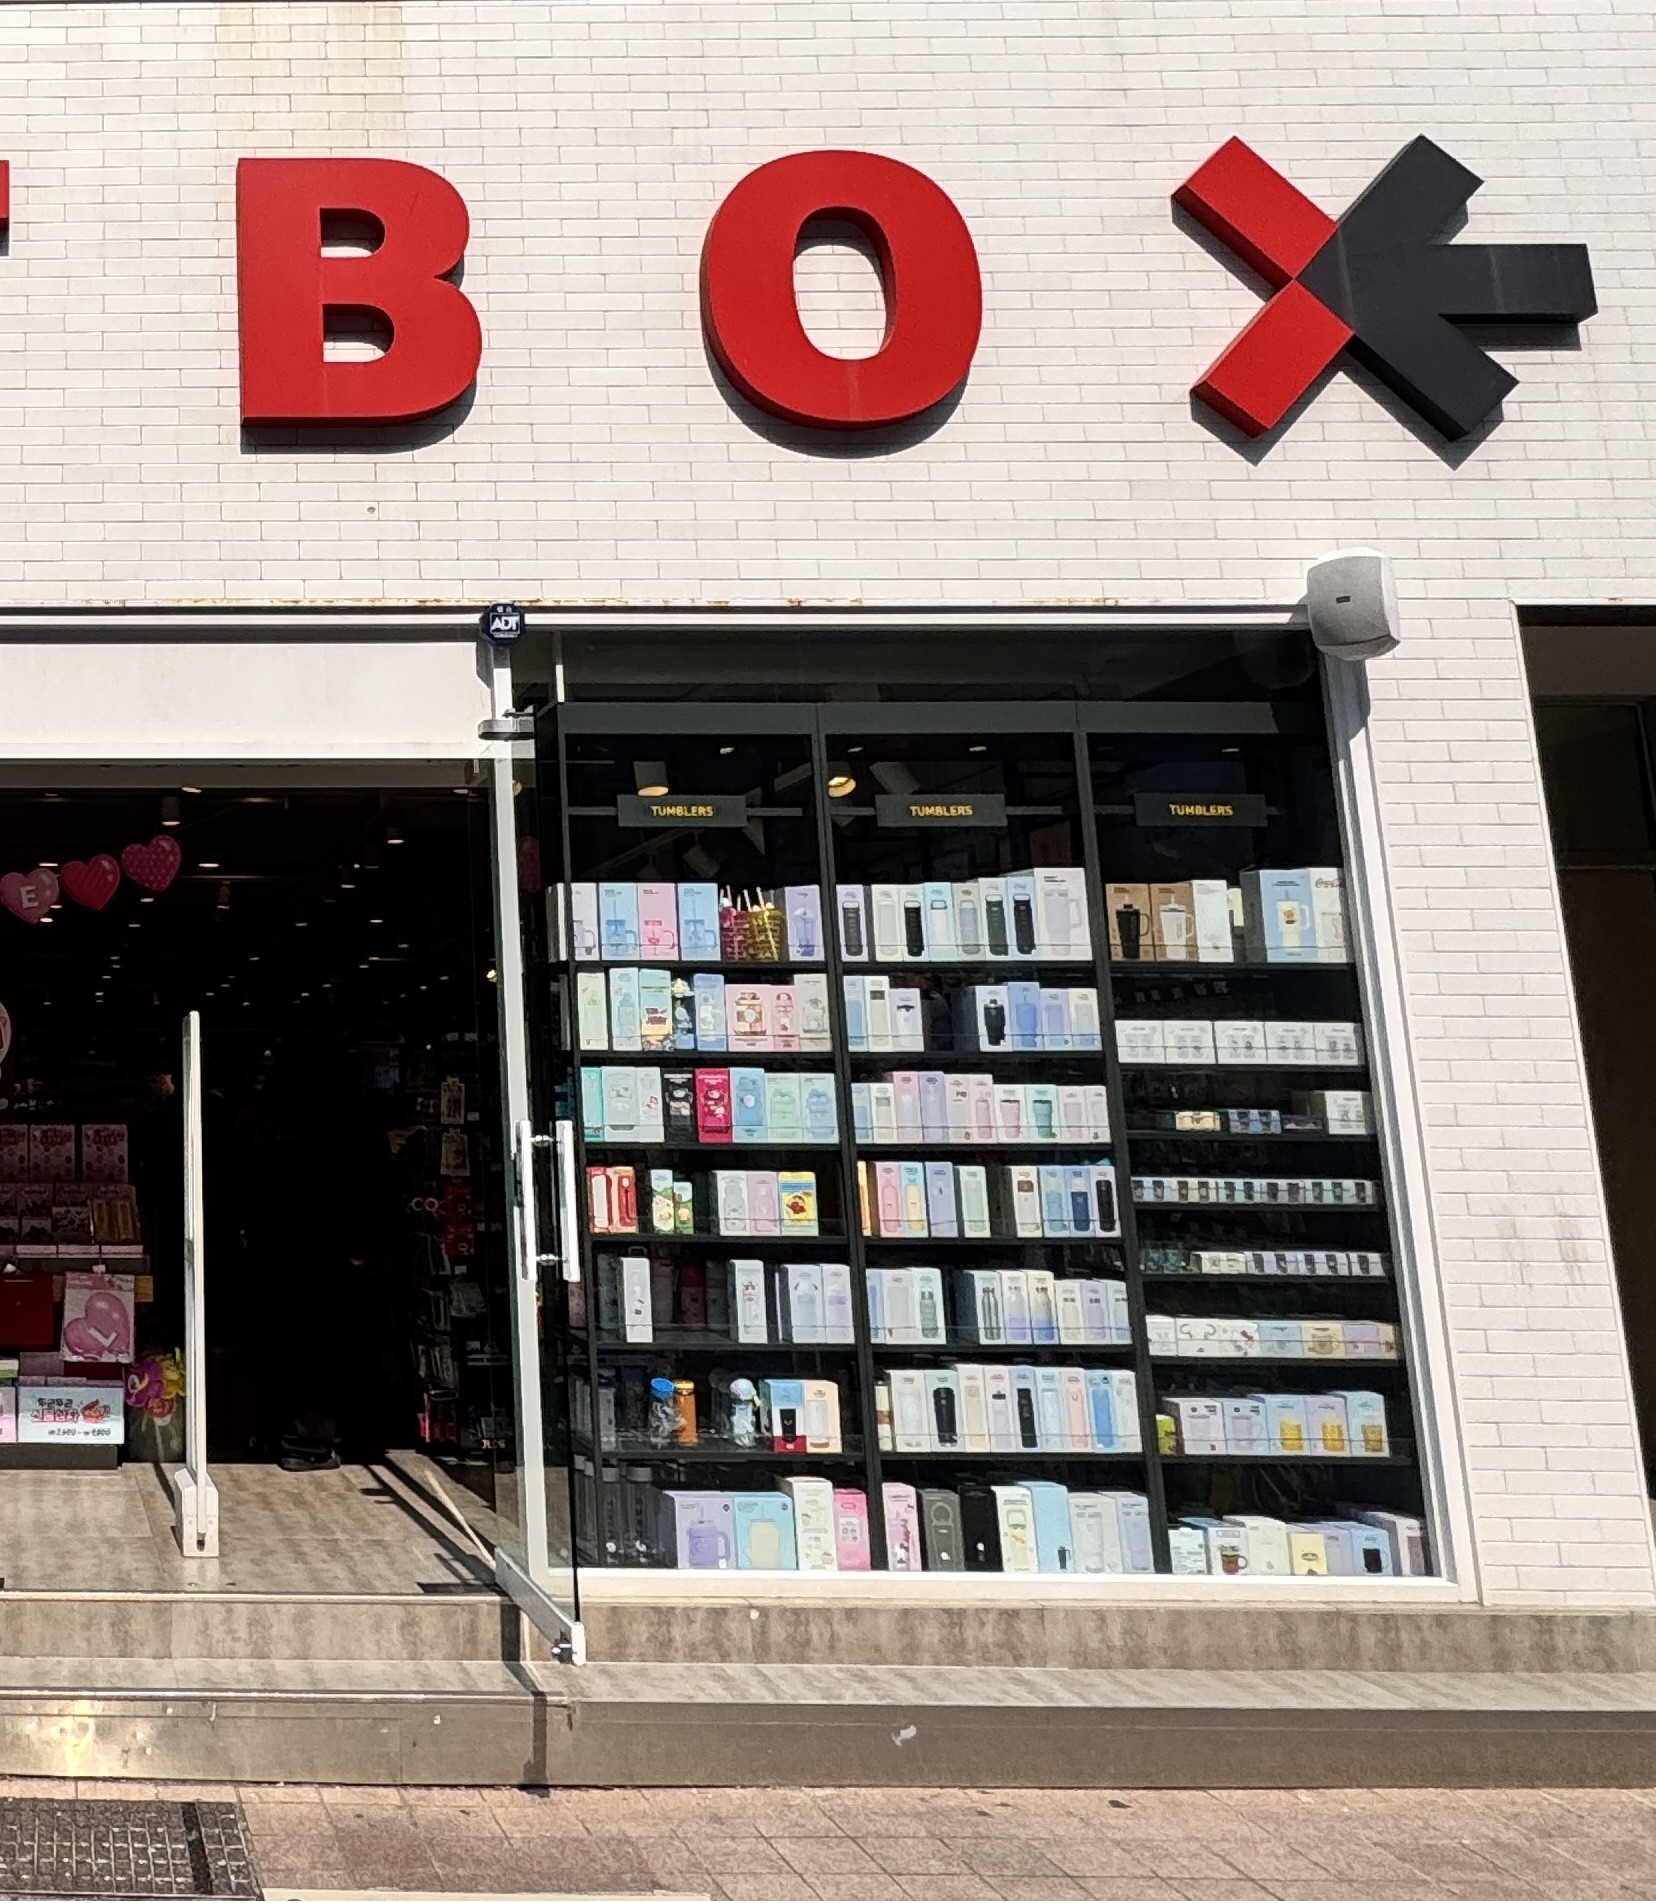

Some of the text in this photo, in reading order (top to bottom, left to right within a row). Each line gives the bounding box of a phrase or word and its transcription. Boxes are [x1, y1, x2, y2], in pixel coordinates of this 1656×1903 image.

[490, 616, 520, 631] ADT
[650, 804, 714, 818] TUMBLERS
[909, 804, 974, 818] TUMBLERS
[1168, 804, 1234, 818] TUMBLERS
